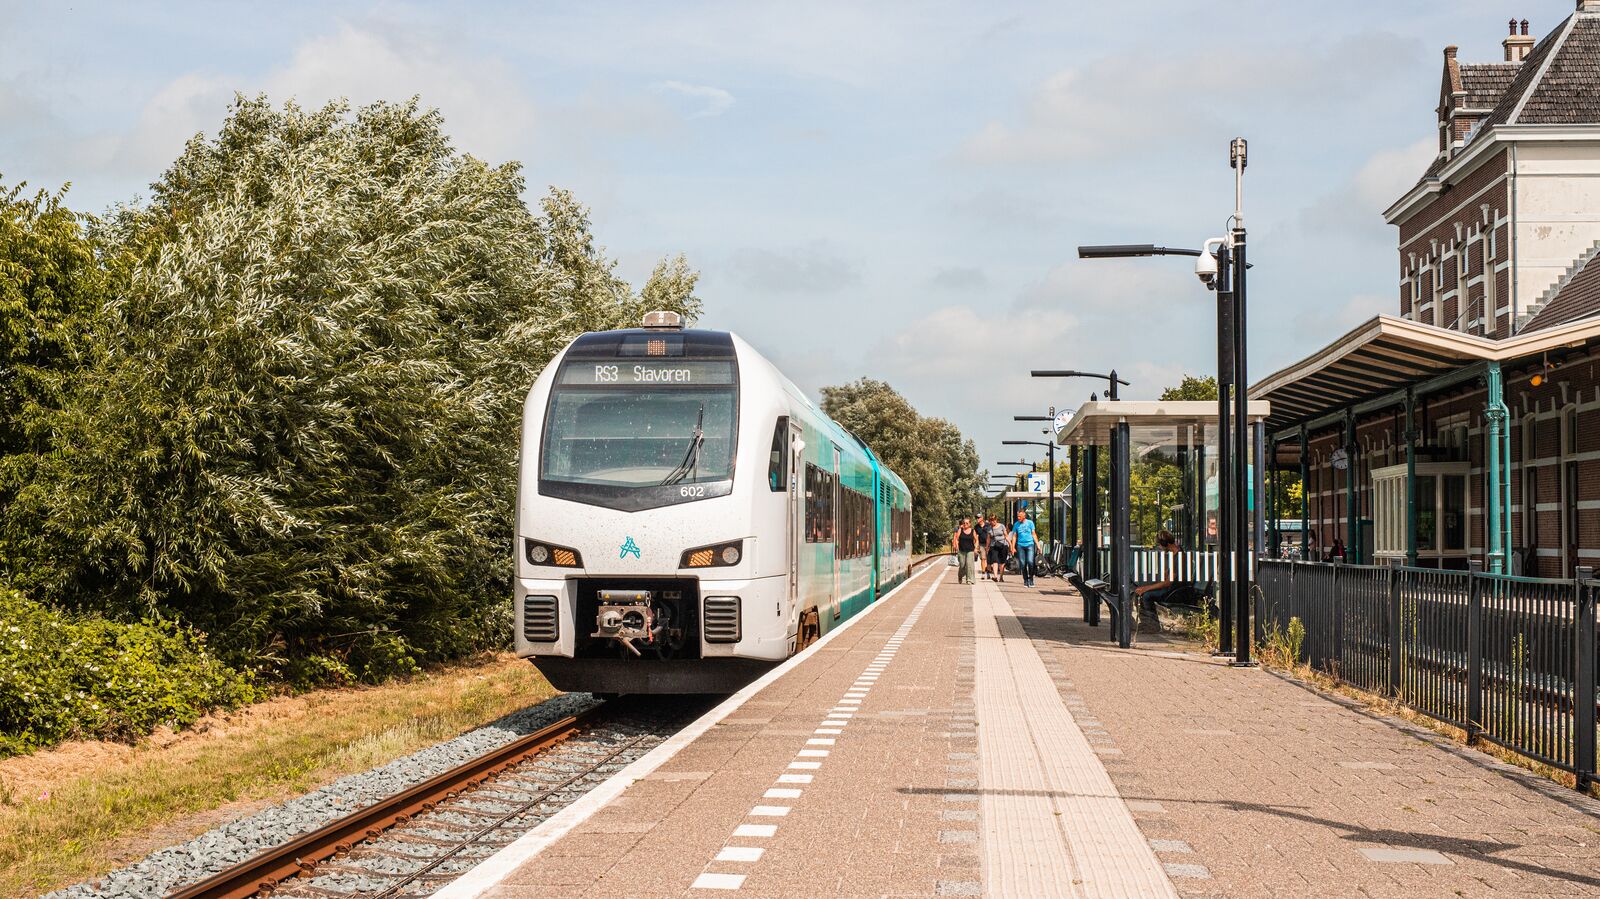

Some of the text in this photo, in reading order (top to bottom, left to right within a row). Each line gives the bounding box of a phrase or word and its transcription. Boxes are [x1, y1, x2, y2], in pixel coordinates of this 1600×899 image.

[595, 365, 691, 382] RS3 Stavoren
[680, 486, 704, 497] 602
